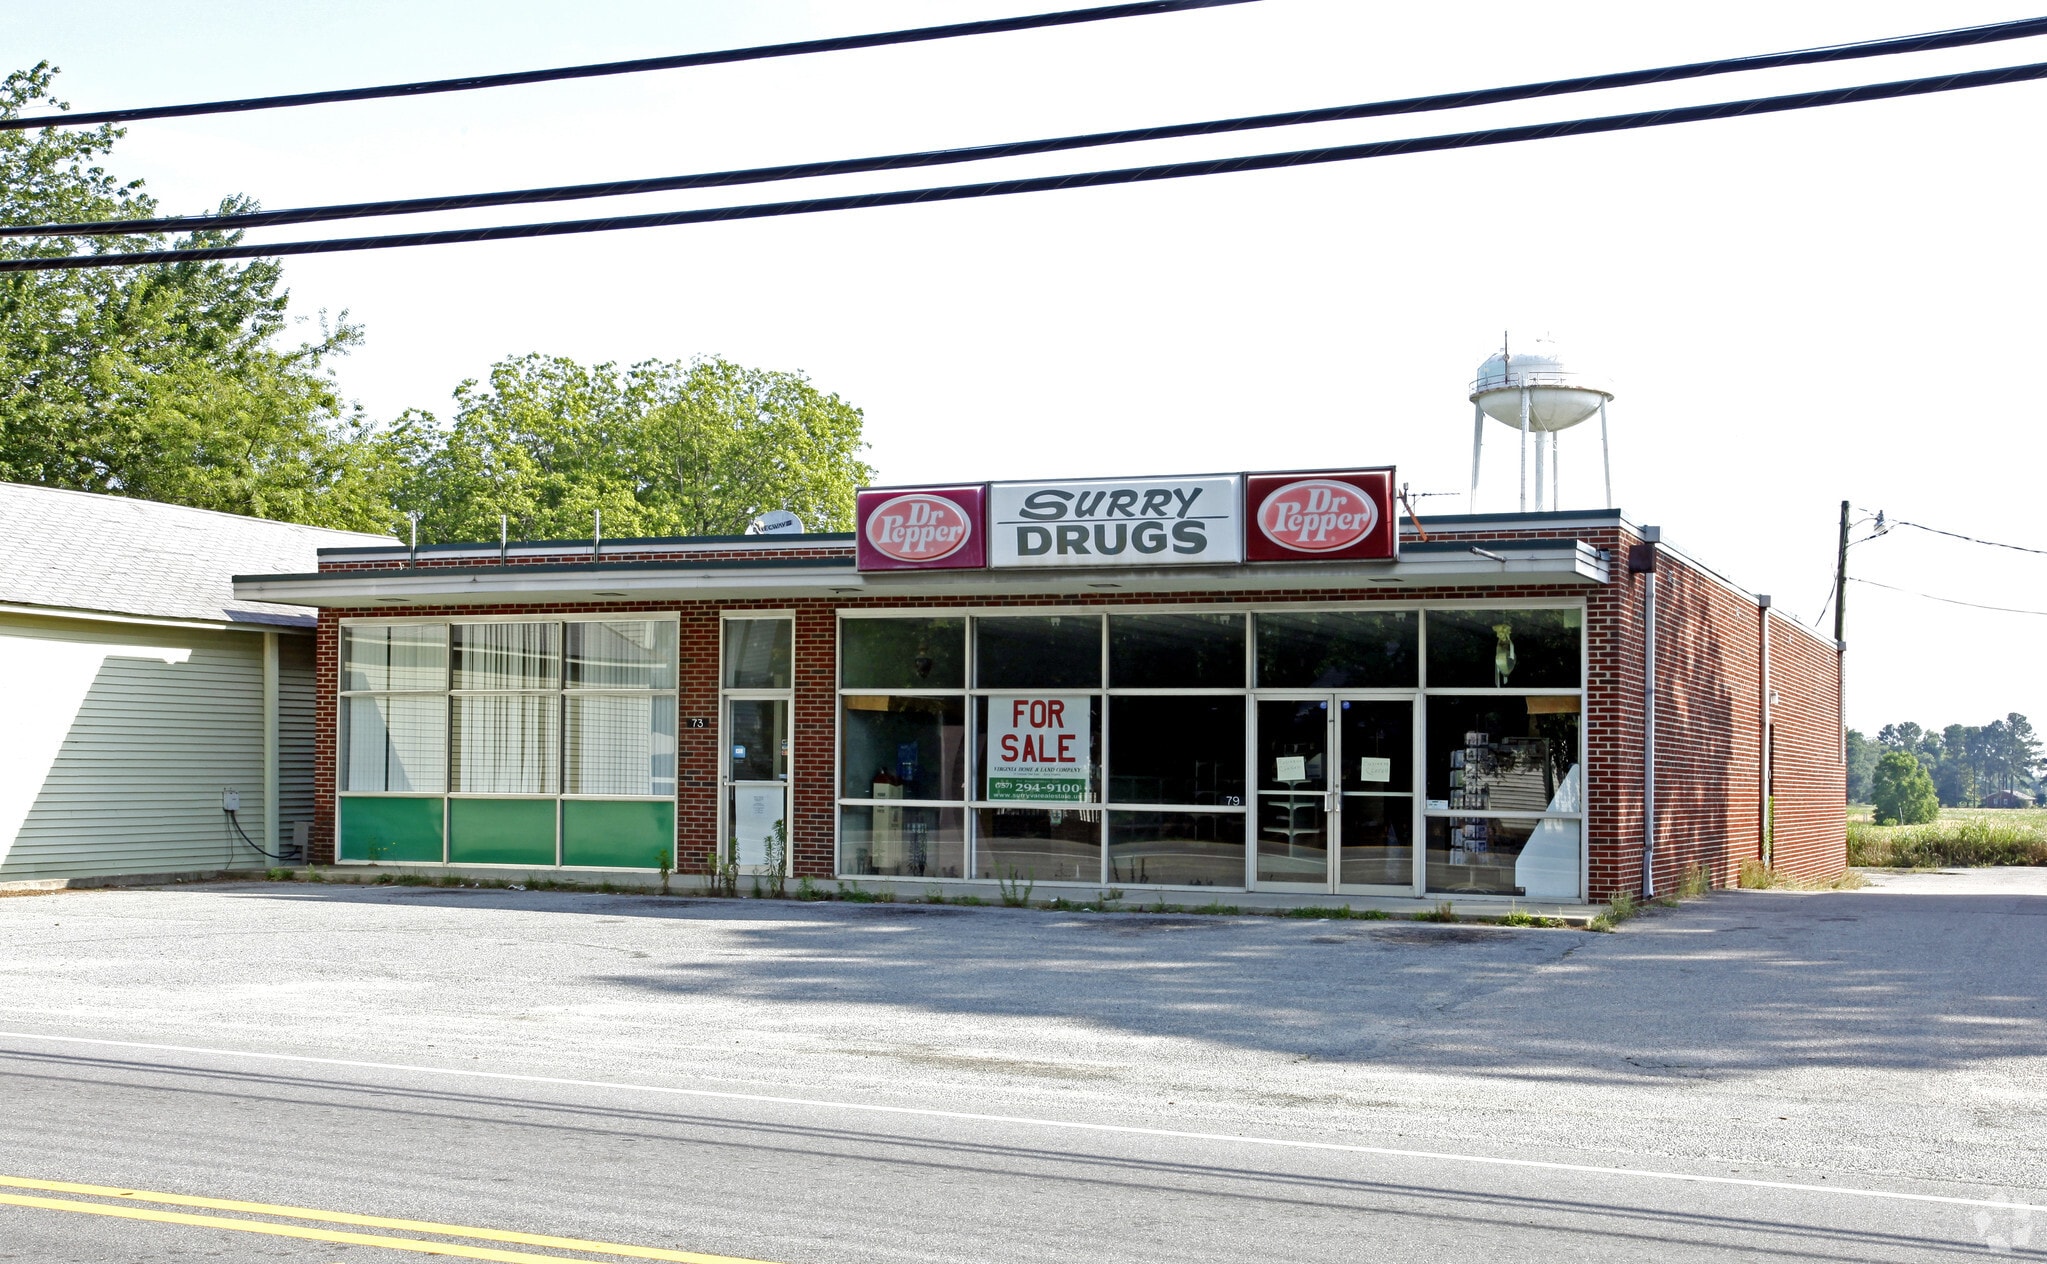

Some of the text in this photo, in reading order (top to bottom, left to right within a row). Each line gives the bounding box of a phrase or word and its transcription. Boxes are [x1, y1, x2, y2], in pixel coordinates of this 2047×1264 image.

[905, 502, 945, 526] Dr
[1019, 487, 1203, 521] SURRY
[1303, 488, 1348, 514] Dr
[877, 515, 963, 553] Pepper
[1271, 501, 1369, 542] Pepper
[1016, 520, 1208, 556] DRUGS
[691, 718, 704, 728] 73
[1012, 699, 1065, 728] FOR
[1000, 733, 1076, 763] SALE
[1015, 783, 1080, 793] 294-9100
[1225, 795, 1240, 806] 79
